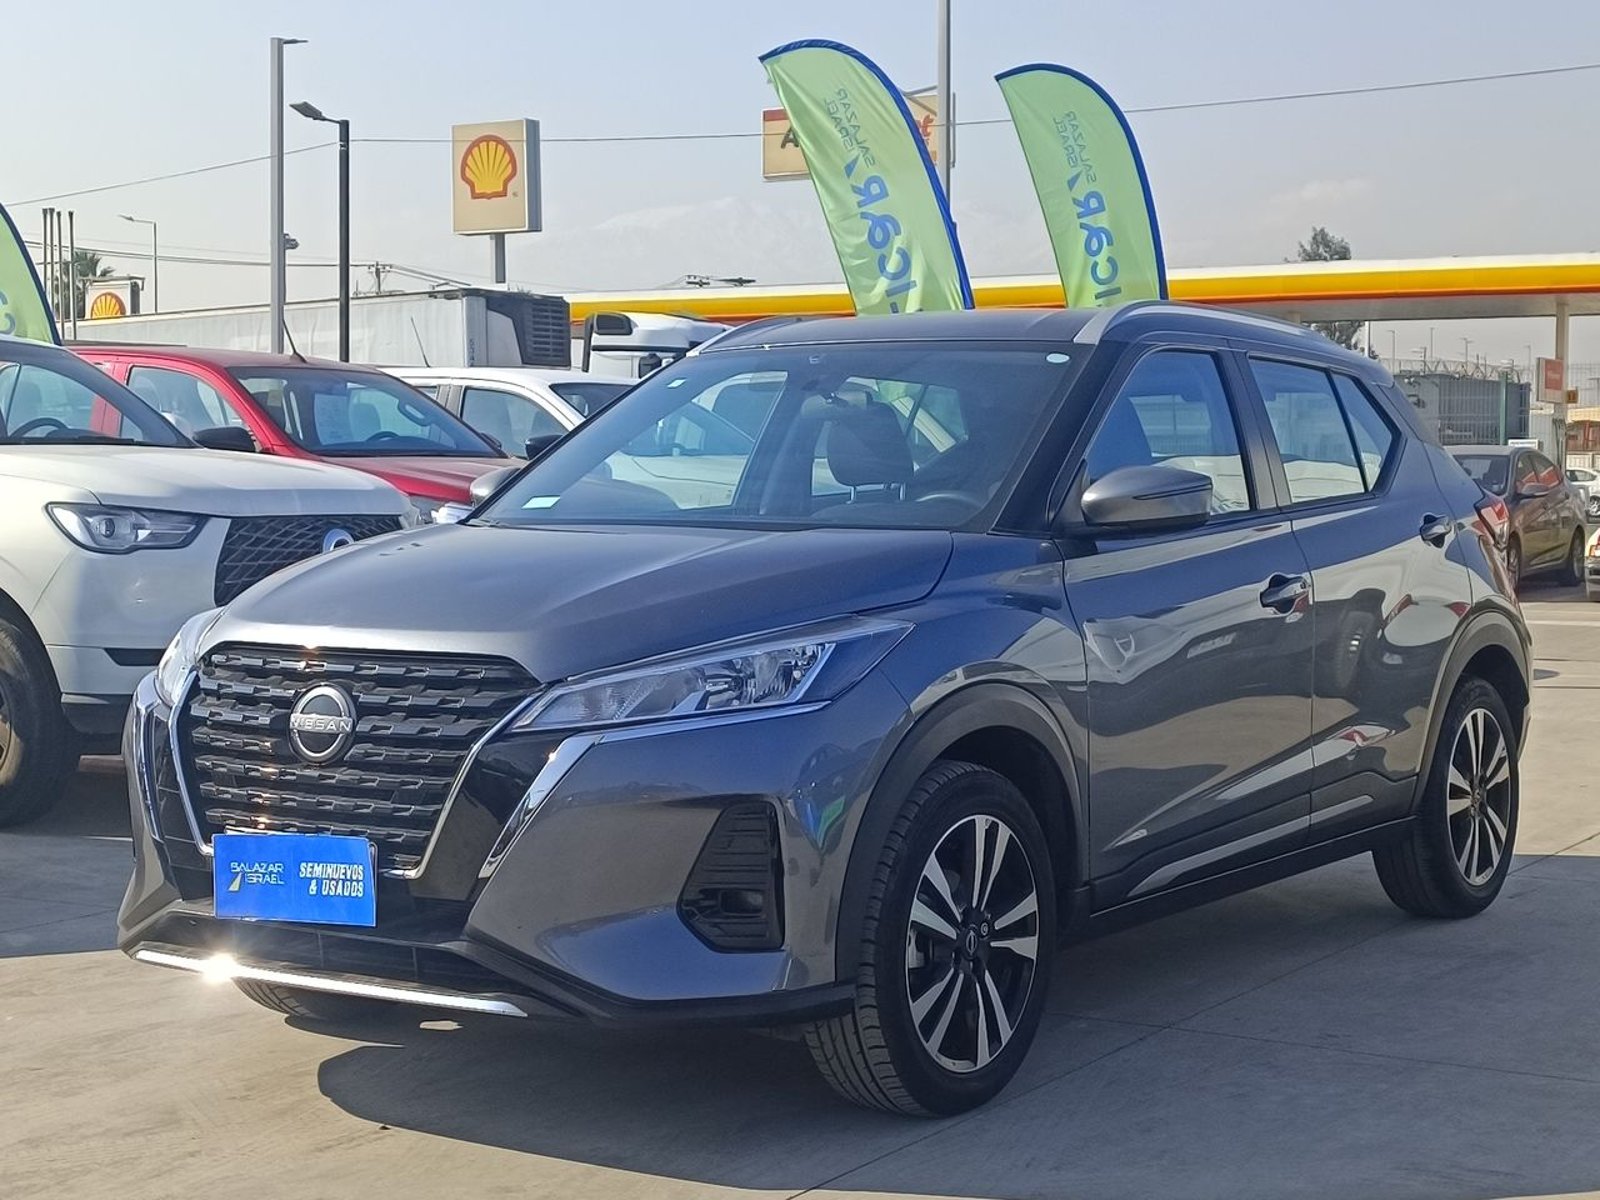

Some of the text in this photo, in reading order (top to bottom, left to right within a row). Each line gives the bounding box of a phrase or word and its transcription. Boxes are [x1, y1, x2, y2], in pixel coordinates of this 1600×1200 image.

[290, 715, 352, 733] NISSAN
[230, 861, 285, 874] SALAZAR
[299, 862, 364, 881] SEMINUEVOS
[244, 873, 285, 885] ISRAEL
[309, 879, 364, 898] & USADOS
